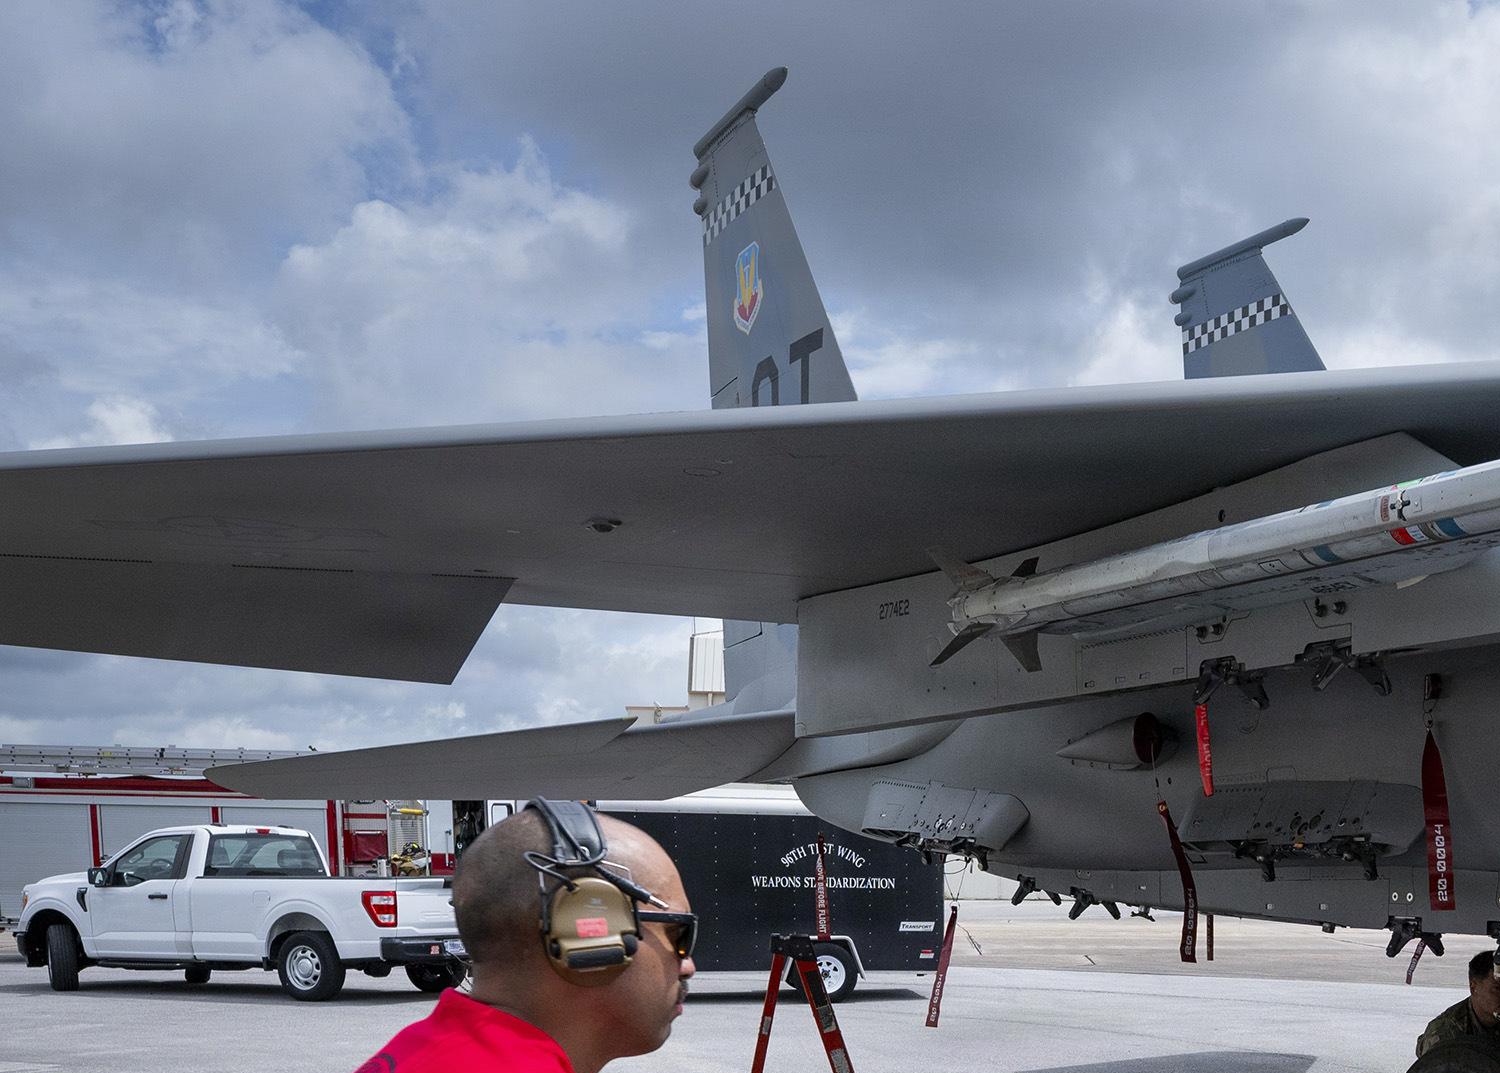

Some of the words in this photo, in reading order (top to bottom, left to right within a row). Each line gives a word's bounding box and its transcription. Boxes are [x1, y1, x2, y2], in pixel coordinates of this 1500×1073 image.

[779, 844, 807, 868] 96TH
[837, 845, 866, 869] WING
[752, 876, 801, 888] WEAPONS
[817, 881, 826, 909] BEFORE
[818, 910, 827, 934] FLIGHT
